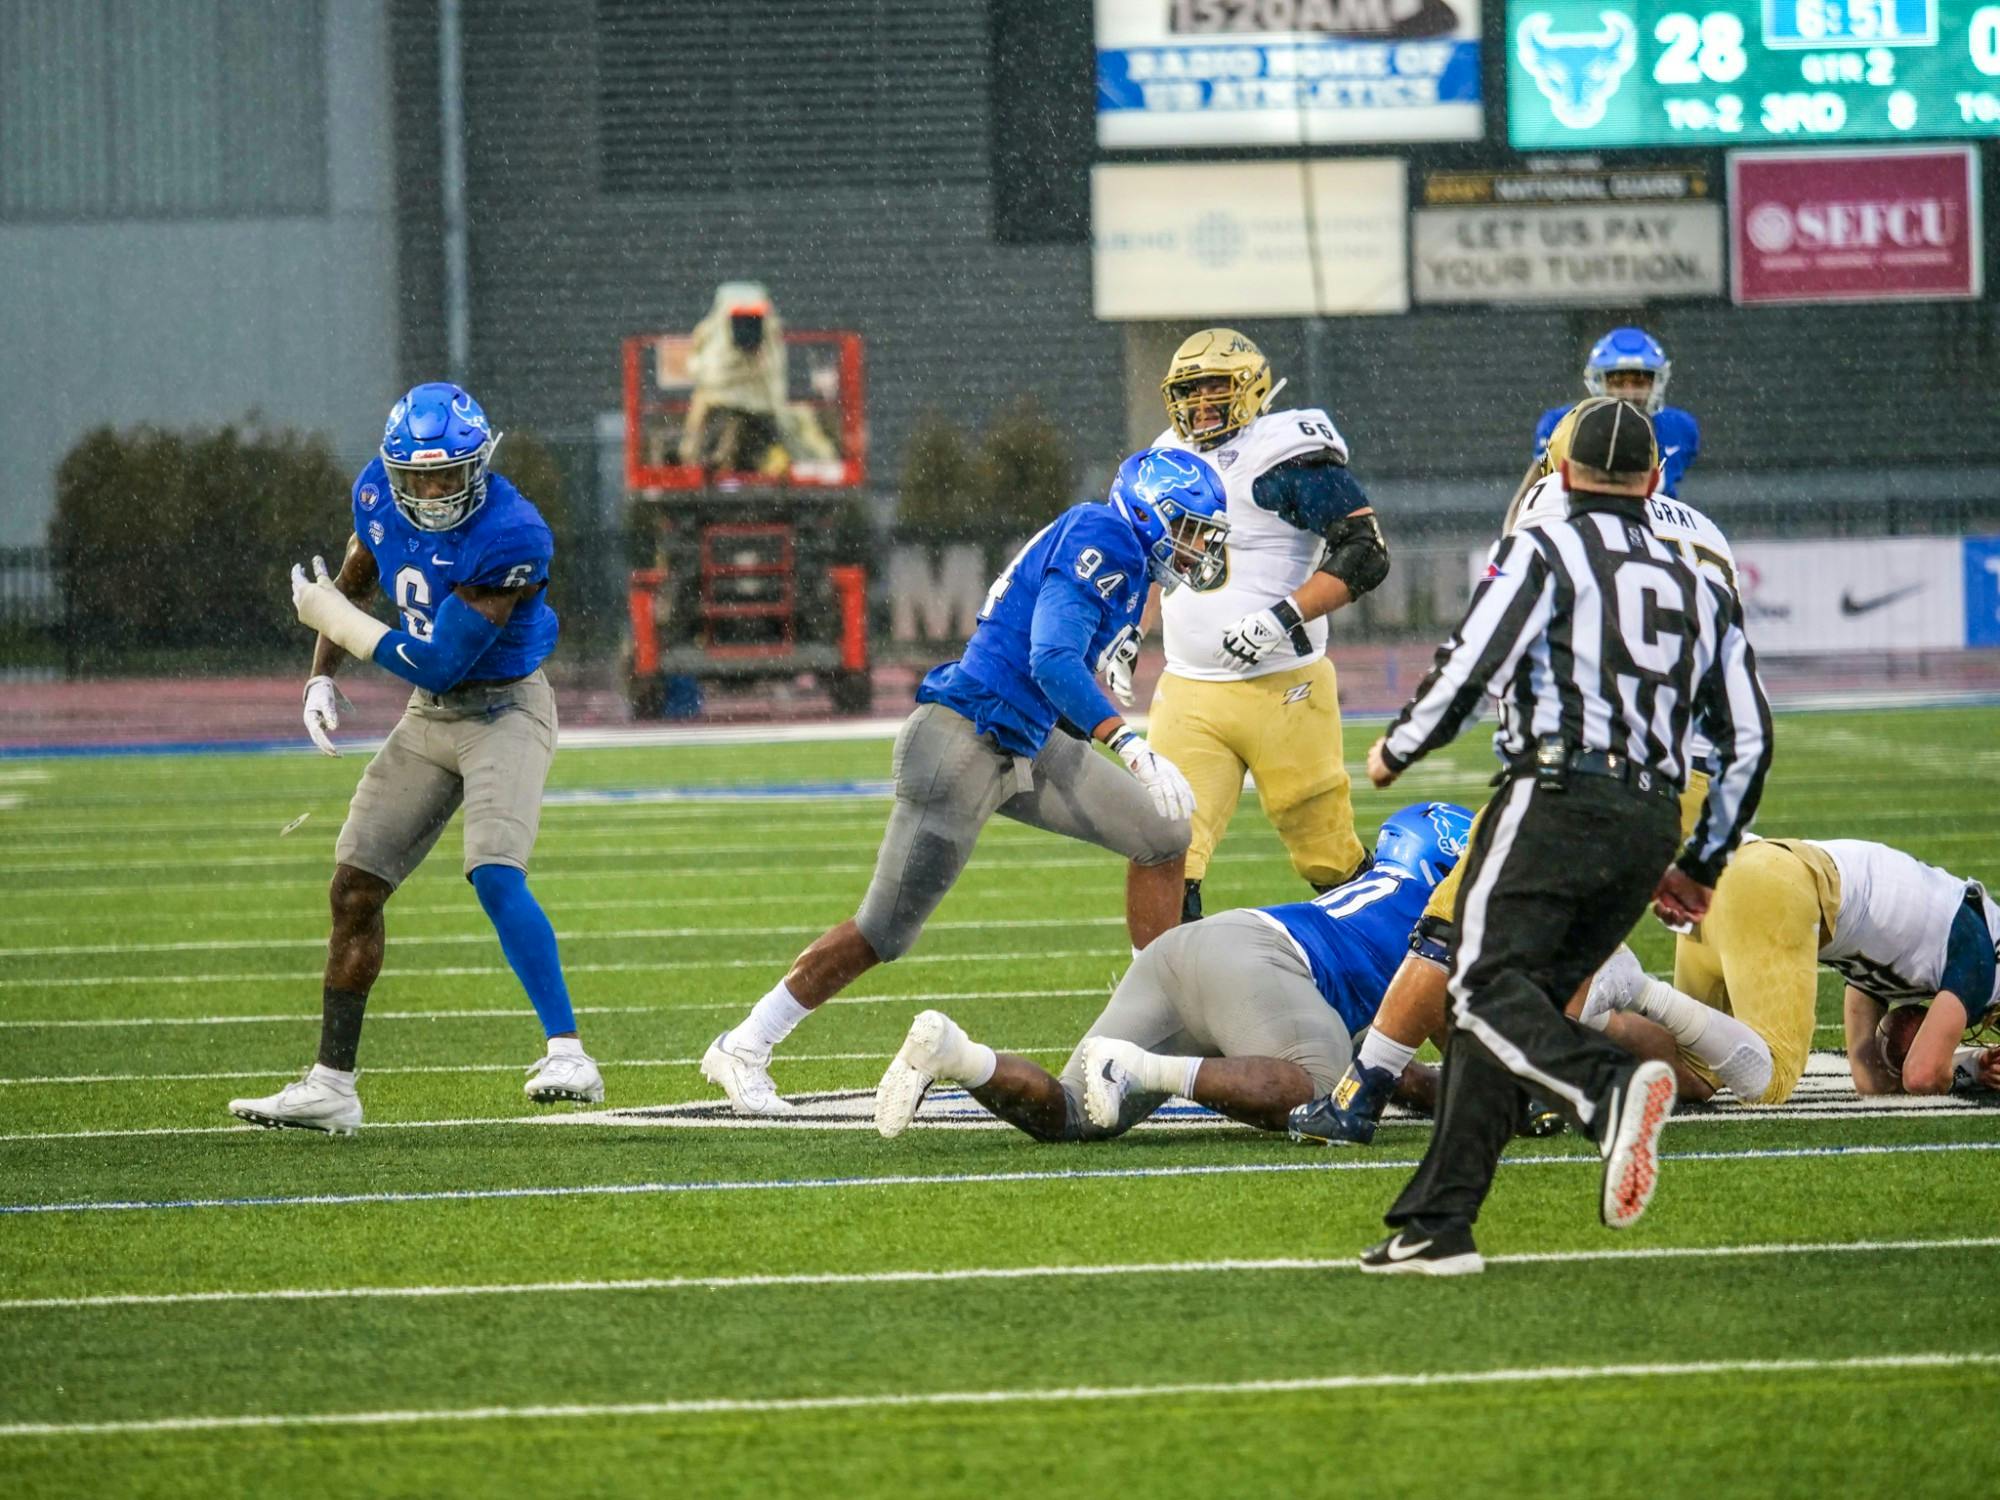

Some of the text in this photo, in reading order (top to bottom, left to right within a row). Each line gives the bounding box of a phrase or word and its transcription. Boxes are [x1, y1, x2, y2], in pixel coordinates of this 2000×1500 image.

[1653, 10, 1747, 84] 28
[1865, 47, 1896, 86] 2
[1760, 92, 1848, 133] 3RD
[1456, 216, 1674, 248] LET US PAY
[1796, 199, 1959, 249] SEFCU
[1423, 254, 1532, 286] YOUR
[1299, 421, 1334, 441] 66
[1075, 546, 1128, 600] 94
[1614, 561, 1683, 674] C
